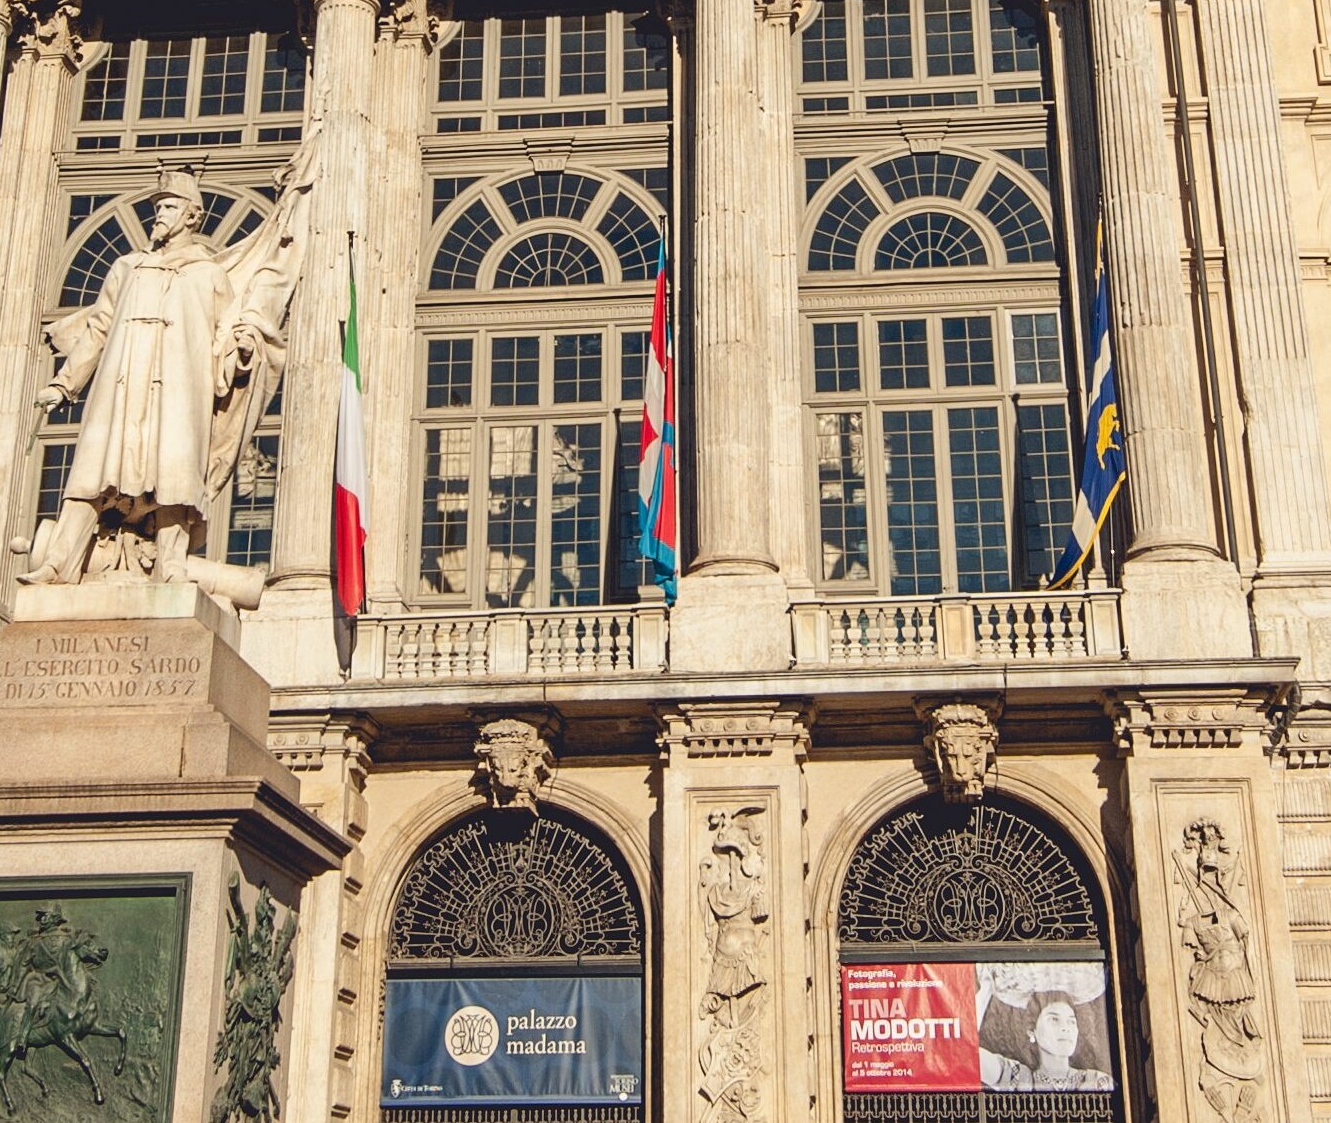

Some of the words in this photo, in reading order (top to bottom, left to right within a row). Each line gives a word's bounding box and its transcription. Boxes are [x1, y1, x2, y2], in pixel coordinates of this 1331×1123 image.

[36, 638, 41, 653] I
[50, 636, 149, 653] MILANESI
[129, 657, 201, 674] SARDO
[5, 683, 23, 699] DI
[56, 680, 137, 698] GENNAIO
[849, 998, 907, 1018] TINA
[506, 1009, 577, 1035] palazzo
[850, 1018, 961, 1040] MODOTTI
[506, 1033, 587, 1054] madama
[852, 1040, 925, 1055] Retrospettiva
